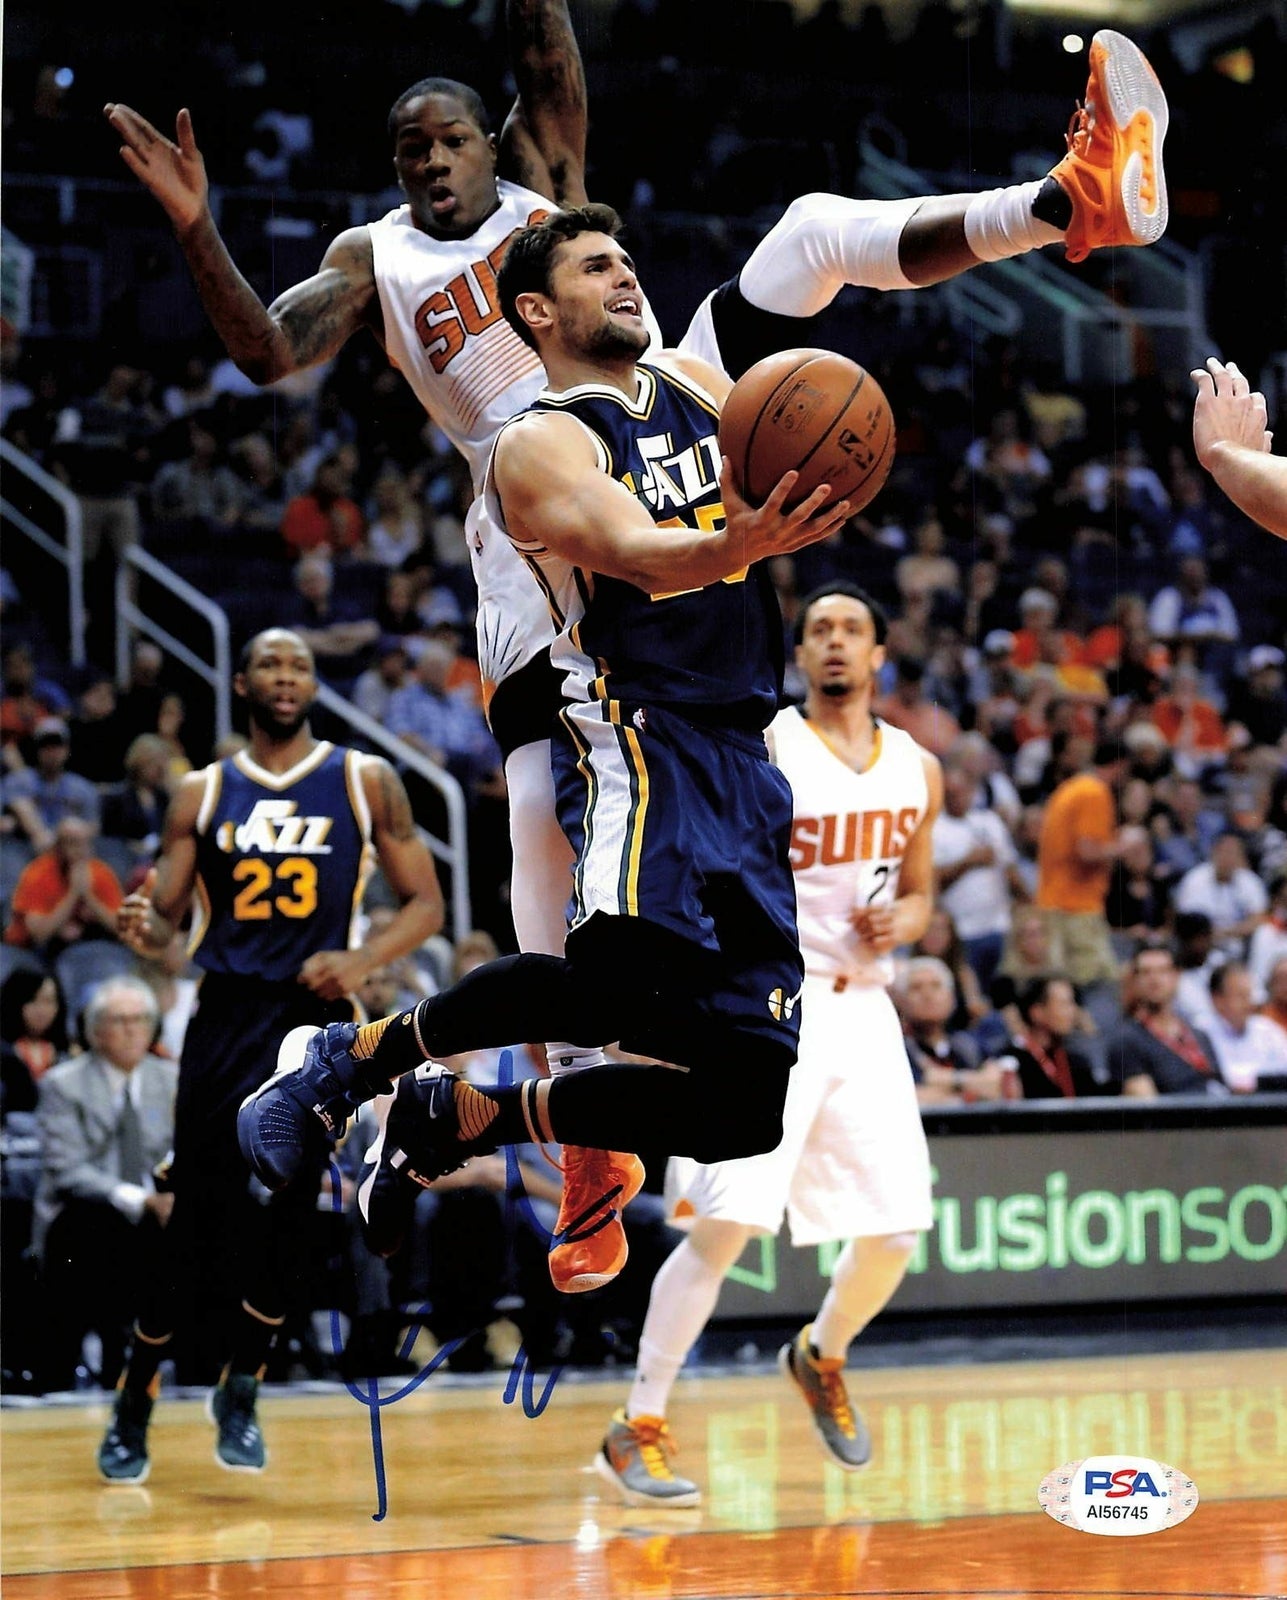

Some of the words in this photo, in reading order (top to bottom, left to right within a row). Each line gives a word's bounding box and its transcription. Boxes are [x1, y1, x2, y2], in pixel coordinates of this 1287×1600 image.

[216, 799, 333, 854] JAZZ
[232, 857, 318, 920] 23
[1086, 1504, 1148, 1520] AI56745
